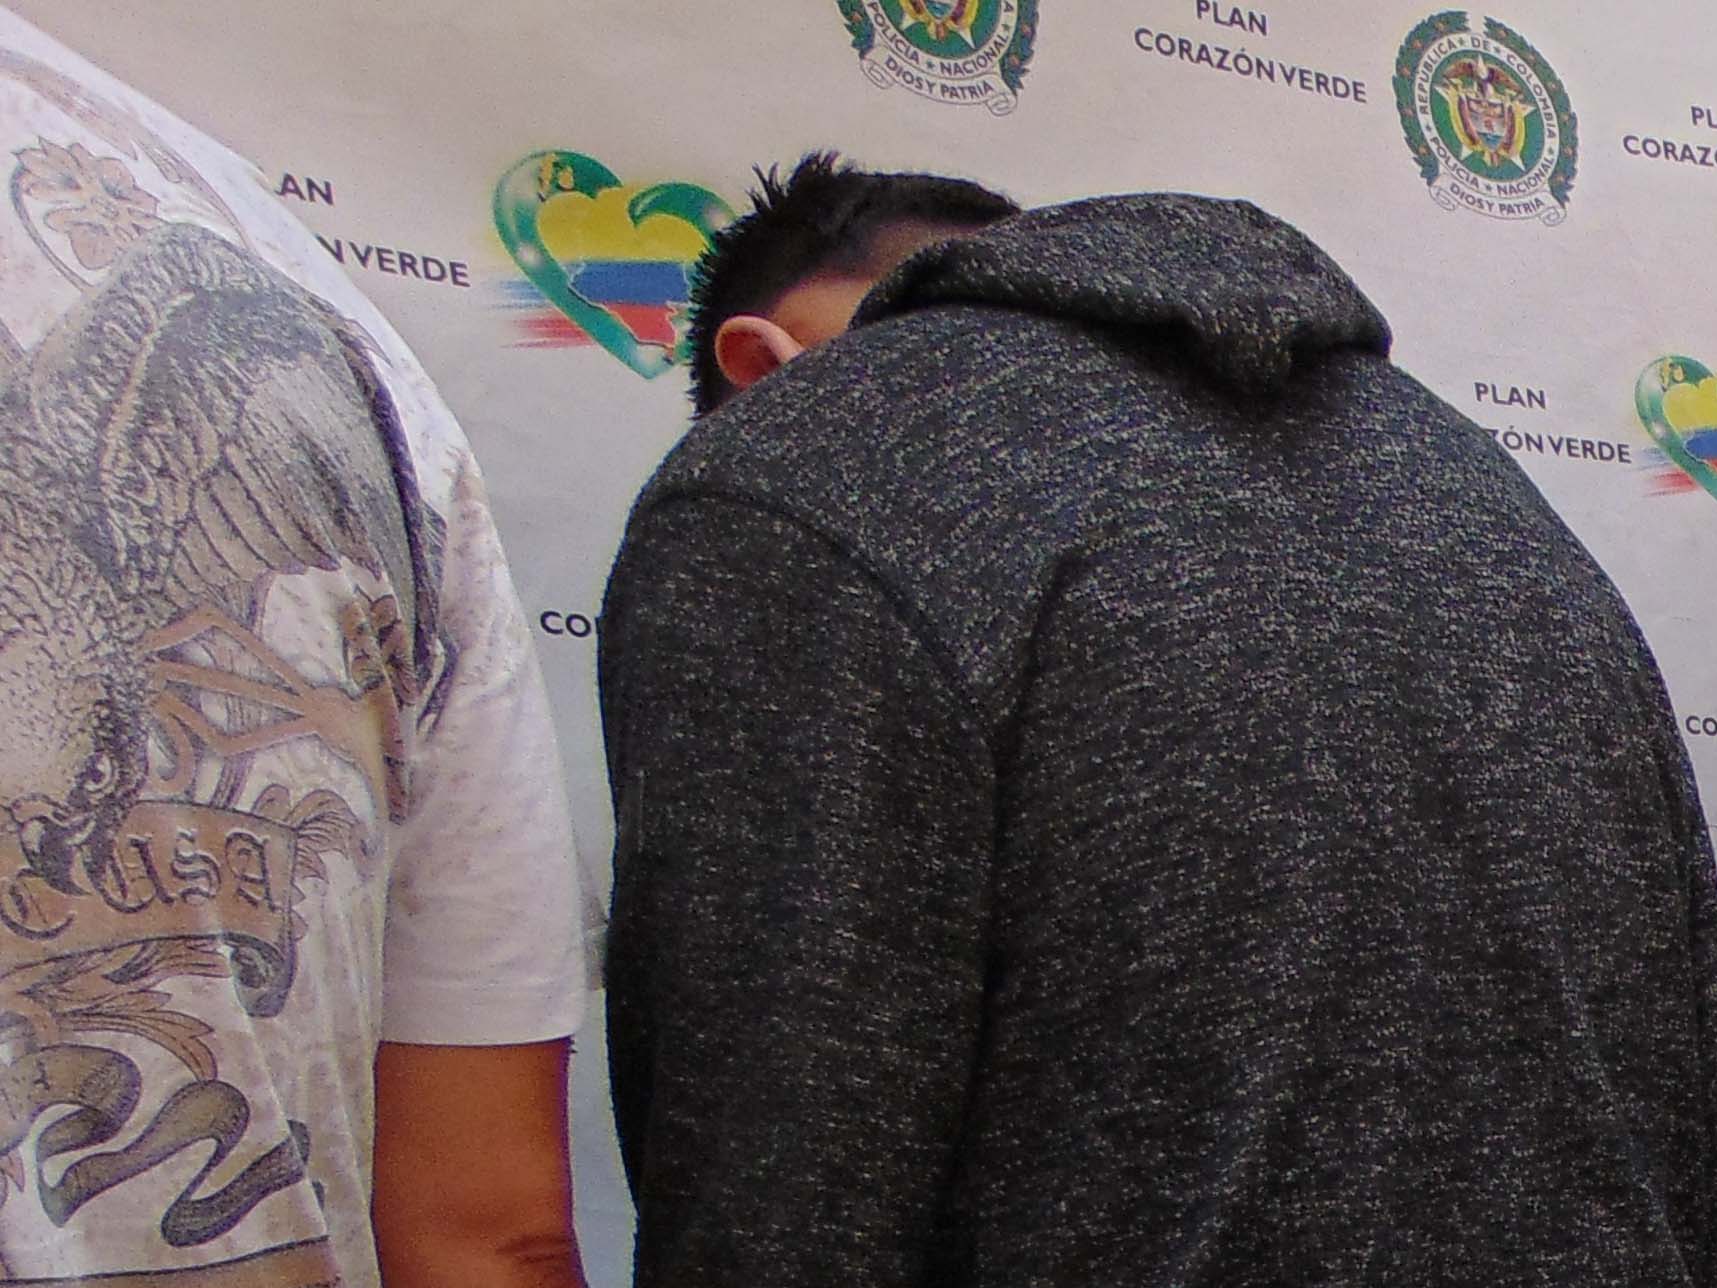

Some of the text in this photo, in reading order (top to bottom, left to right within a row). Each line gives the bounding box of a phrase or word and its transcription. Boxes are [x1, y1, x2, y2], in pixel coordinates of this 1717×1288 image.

[1196, 0, 1268, 36] PLAN
[939, 35, 1008, 76] NACIONAL
[1134, 28, 1368, 103] CORAZÓN VERDE
[940, 80, 994, 100] PATRIA
[1470, 35, 1491, 50] DE
[1506, 54, 1557, 139] COLOMBIA
[282, 172, 335, 206] AN
[1496, 157, 1555, 196] NACIONAL
[1499, 197, 1545, 215] PATRIA
[349, 241, 471, 288] VERDE
[1474, 382, 1547, 410] PLAN
[1548, 436, 1632, 464] VERDE
